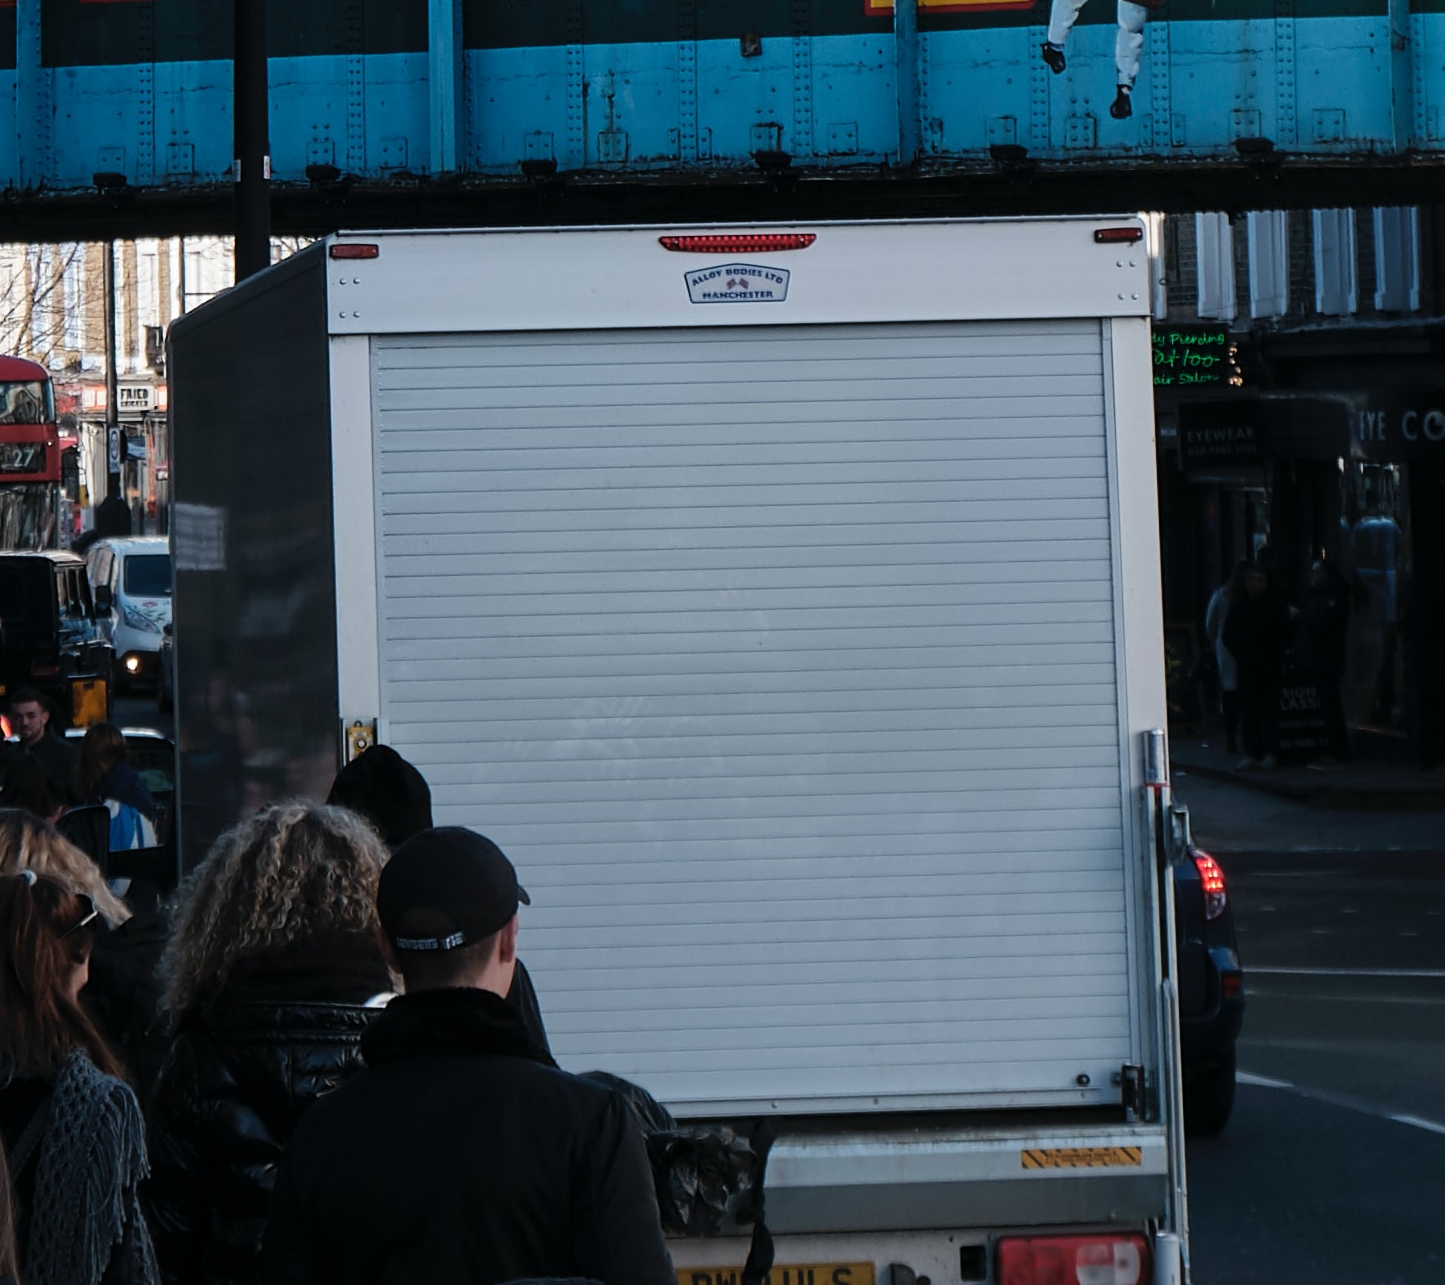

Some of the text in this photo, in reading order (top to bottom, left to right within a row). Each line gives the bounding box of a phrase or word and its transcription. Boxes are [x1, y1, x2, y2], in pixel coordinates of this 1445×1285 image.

[691, 268, 783, 287] ALLOY BODIES LTD
[702, 291, 774, 300] MANCHESTER
[1154, 349, 1220, 368] attoo
[1154, 375, 1175, 386] air
[120, 388, 149, 399] FRIED
[1359, 409, 1387, 441] EYE
[14, 449, 35, 468] 27
